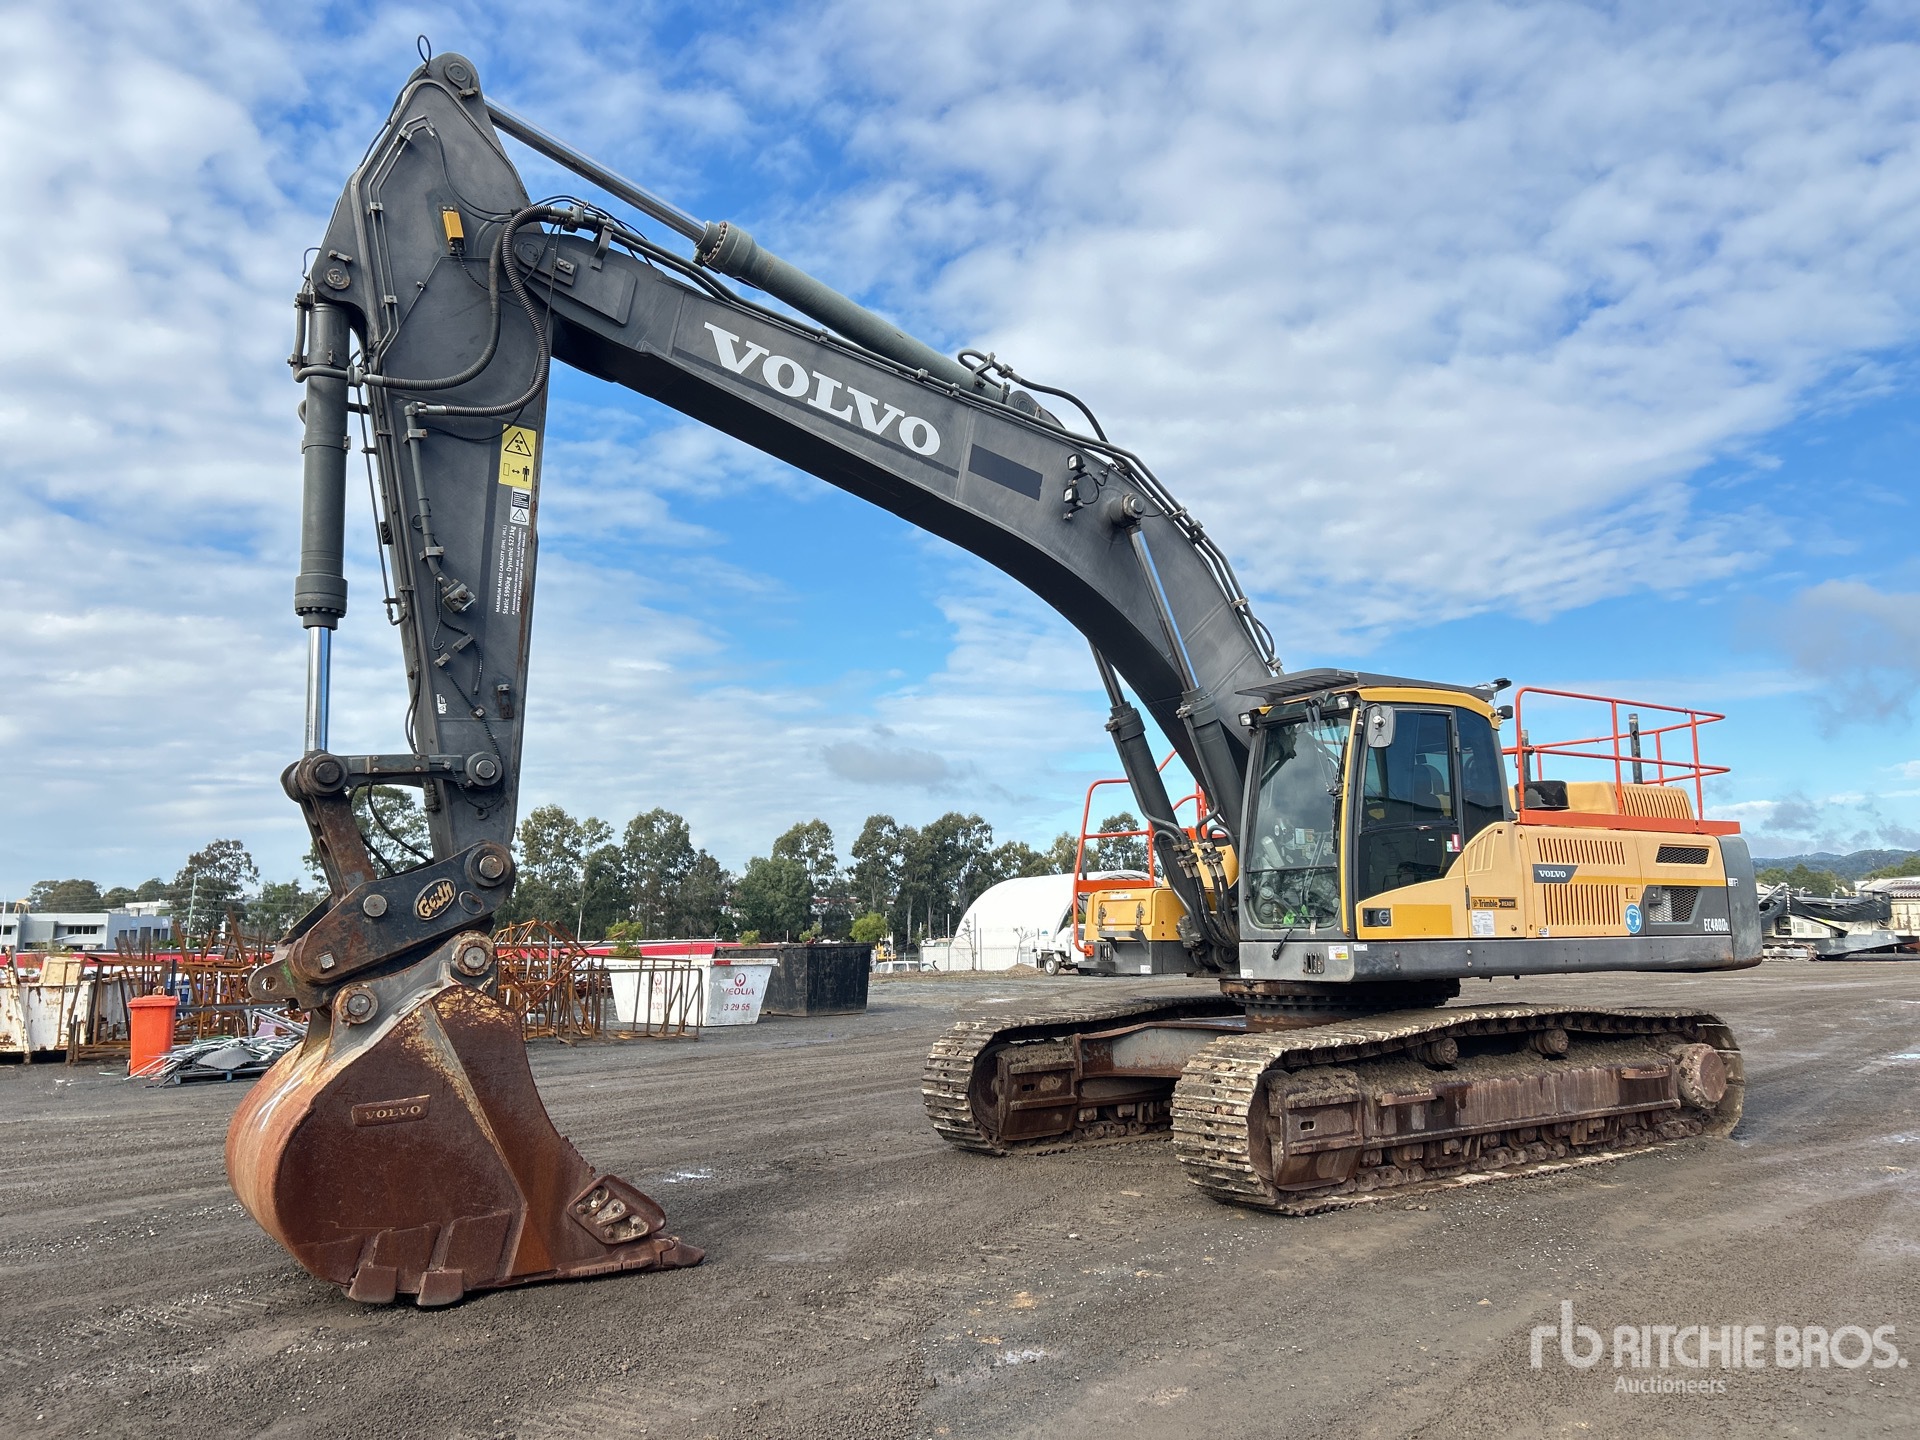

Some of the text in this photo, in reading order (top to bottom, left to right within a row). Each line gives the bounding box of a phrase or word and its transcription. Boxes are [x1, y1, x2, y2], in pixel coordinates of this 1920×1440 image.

[704, 321, 941, 456] VOLVO
[508, 526, 516, 546] 5271kg
[1538, 870, 1567, 878] VOLVO
[1479, 899, 1498, 908] Trimble
[730, 1003, 740, 1011] 29
[741, 1003, 751, 1011] 55
[365, 1105, 421, 1120] VOLVO
